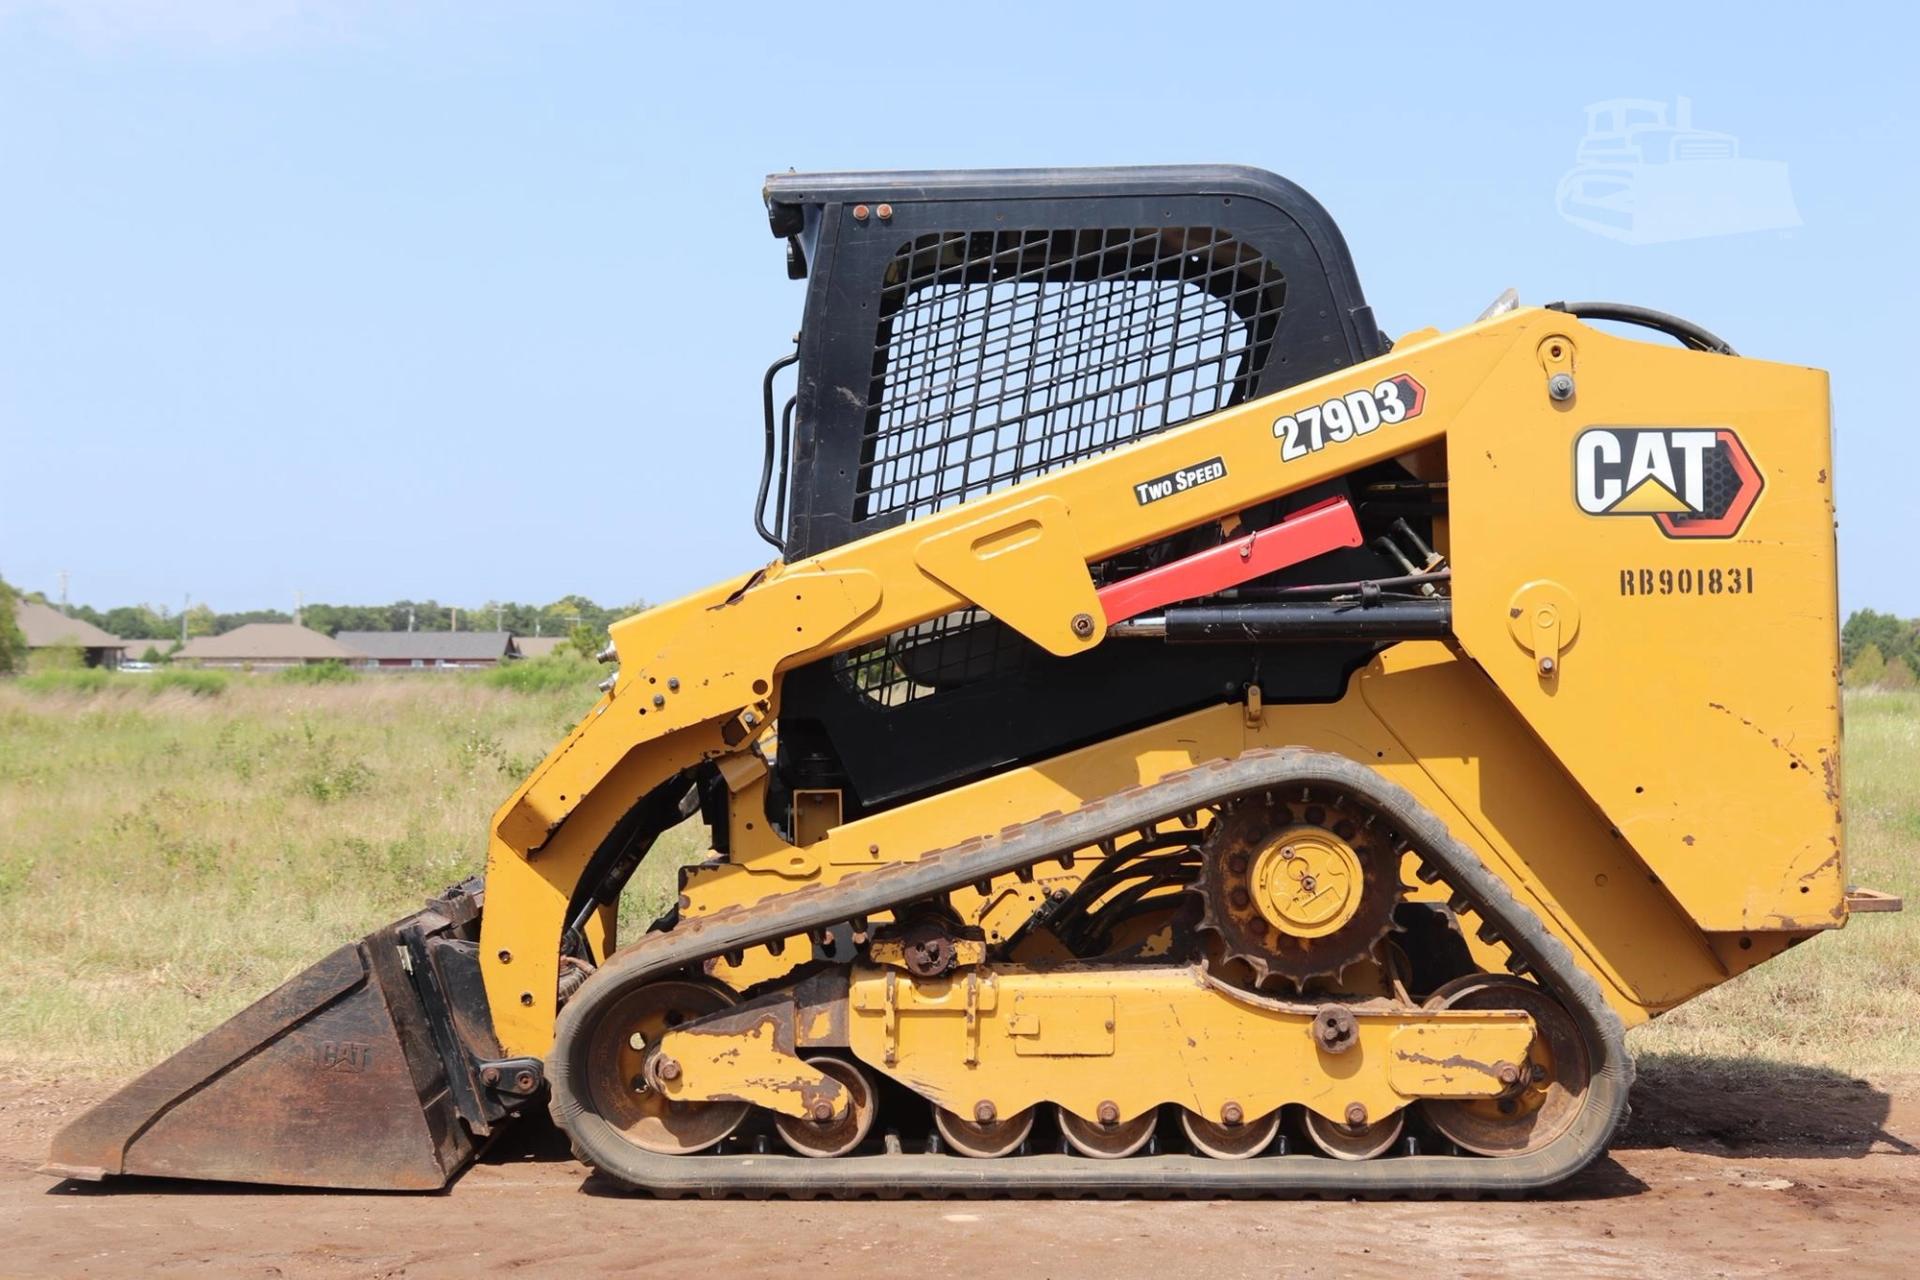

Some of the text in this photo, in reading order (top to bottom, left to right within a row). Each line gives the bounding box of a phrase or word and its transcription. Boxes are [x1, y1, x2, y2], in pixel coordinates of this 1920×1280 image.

[1273, 380, 1406, 462] 279D3
[1576, 430, 1716, 513] CAT
[1620, 567, 1753, 596] RB901831
[321, 1040, 370, 1073] CAT
